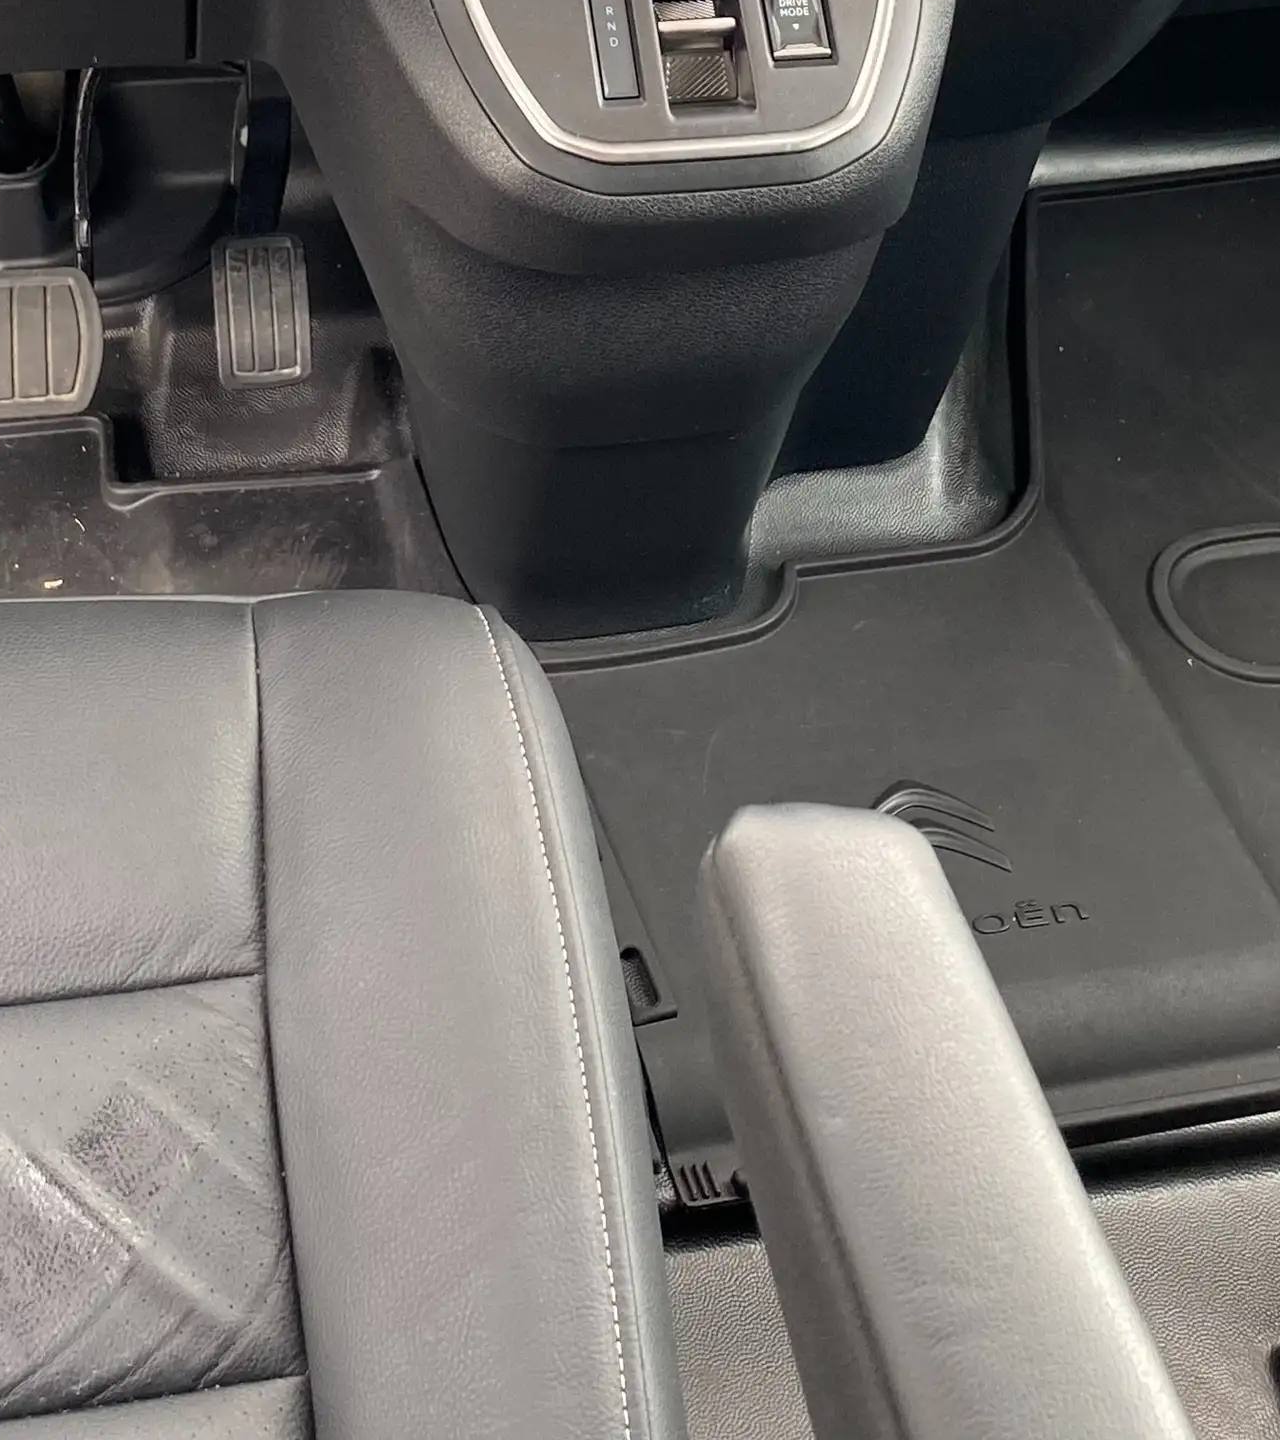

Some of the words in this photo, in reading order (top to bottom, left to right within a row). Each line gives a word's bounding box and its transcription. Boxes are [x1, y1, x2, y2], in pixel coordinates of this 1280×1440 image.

[605, 6, 613, 16] R
[780, 6, 809, 17] MODE
[607, 22, 616, 31] N
[609, 37, 619, 47] D
